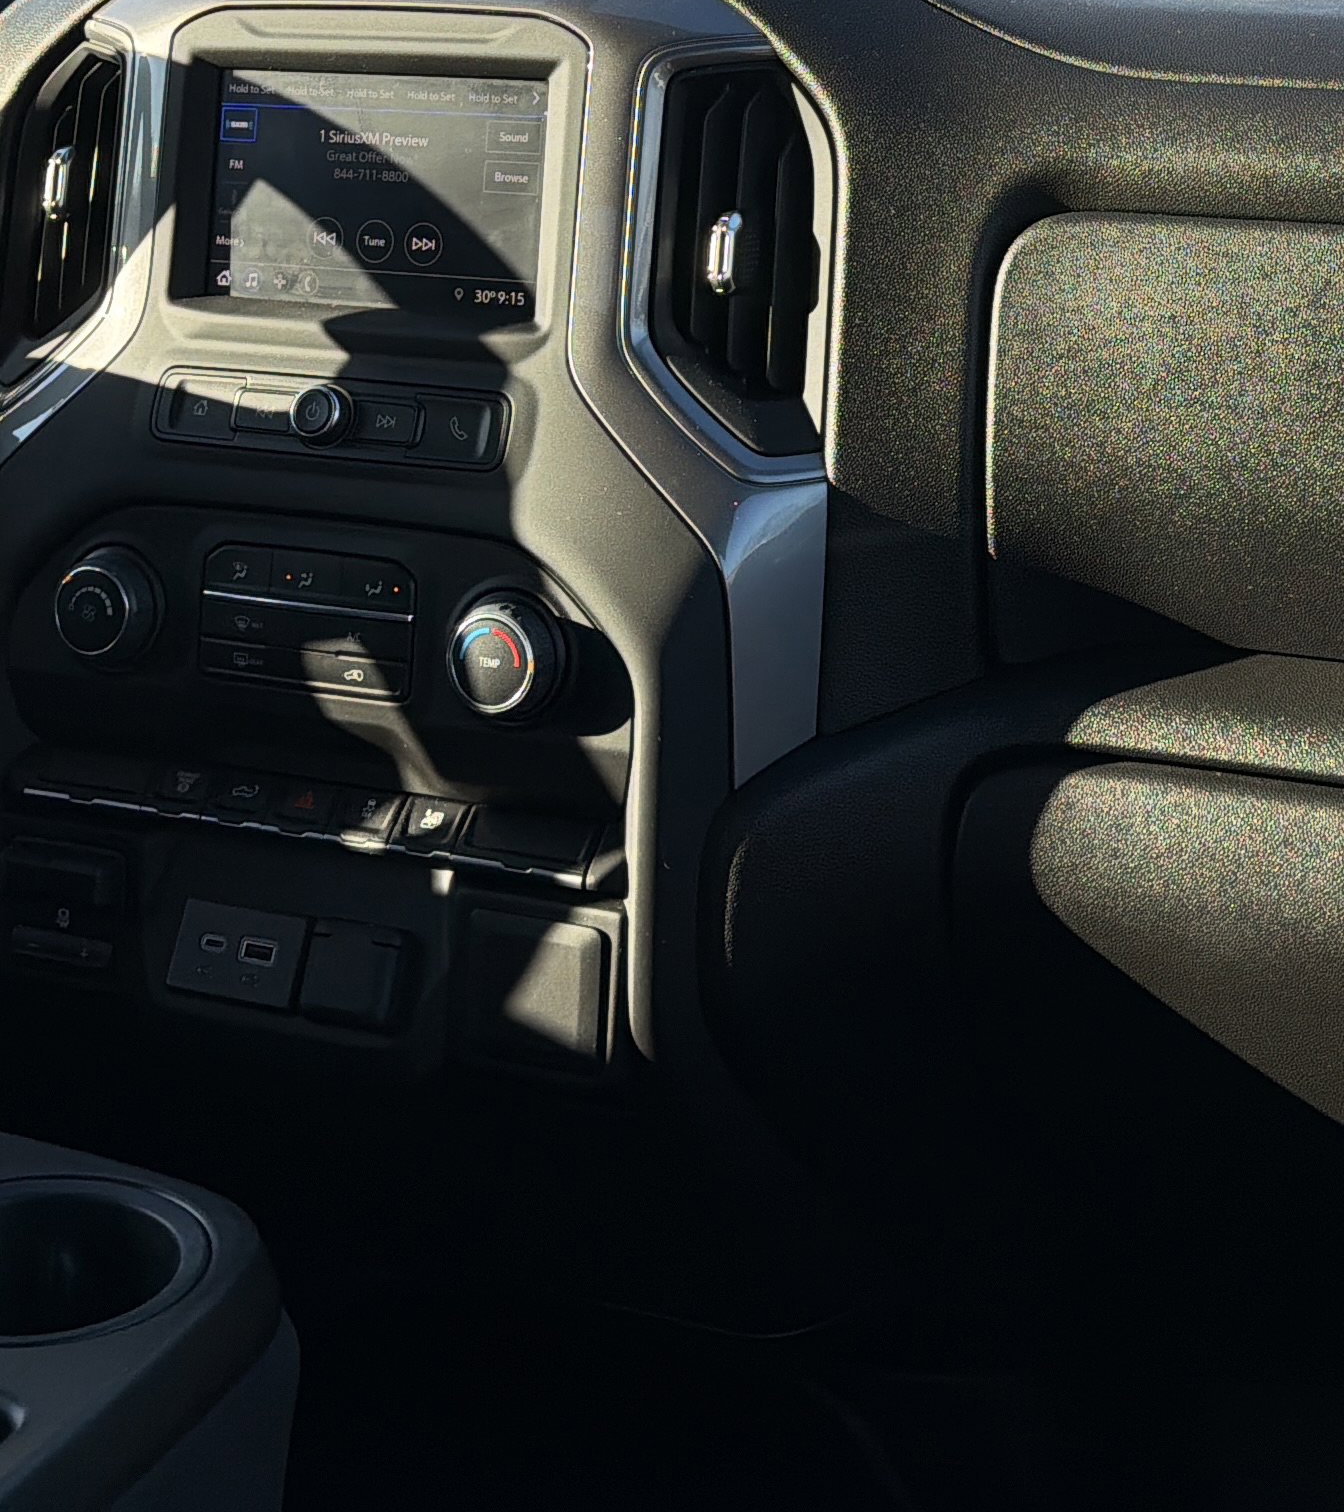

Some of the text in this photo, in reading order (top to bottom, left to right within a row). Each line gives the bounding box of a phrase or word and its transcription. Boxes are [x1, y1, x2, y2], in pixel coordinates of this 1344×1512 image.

[228, 83, 276, 96] Hold to Set
[407, 90, 455, 101] Hold to Set
[468, 93, 518, 104] Hold to Set
[319, 129, 429, 148] 1 SiriusXM Preview
[499, 131, 528, 143] Sound
[326, 149, 357, 162] Great
[359, 151, 386, 163] Offer
[229, 159, 244, 170] FM
[333, 169, 409, 183] 844-711-8800
[494, 171, 529, 184] Browse
[363, 236, 386, 247] Tune
[497, 291, 525, 306] 9:15
[478, 656, 501, 669] TEMP
